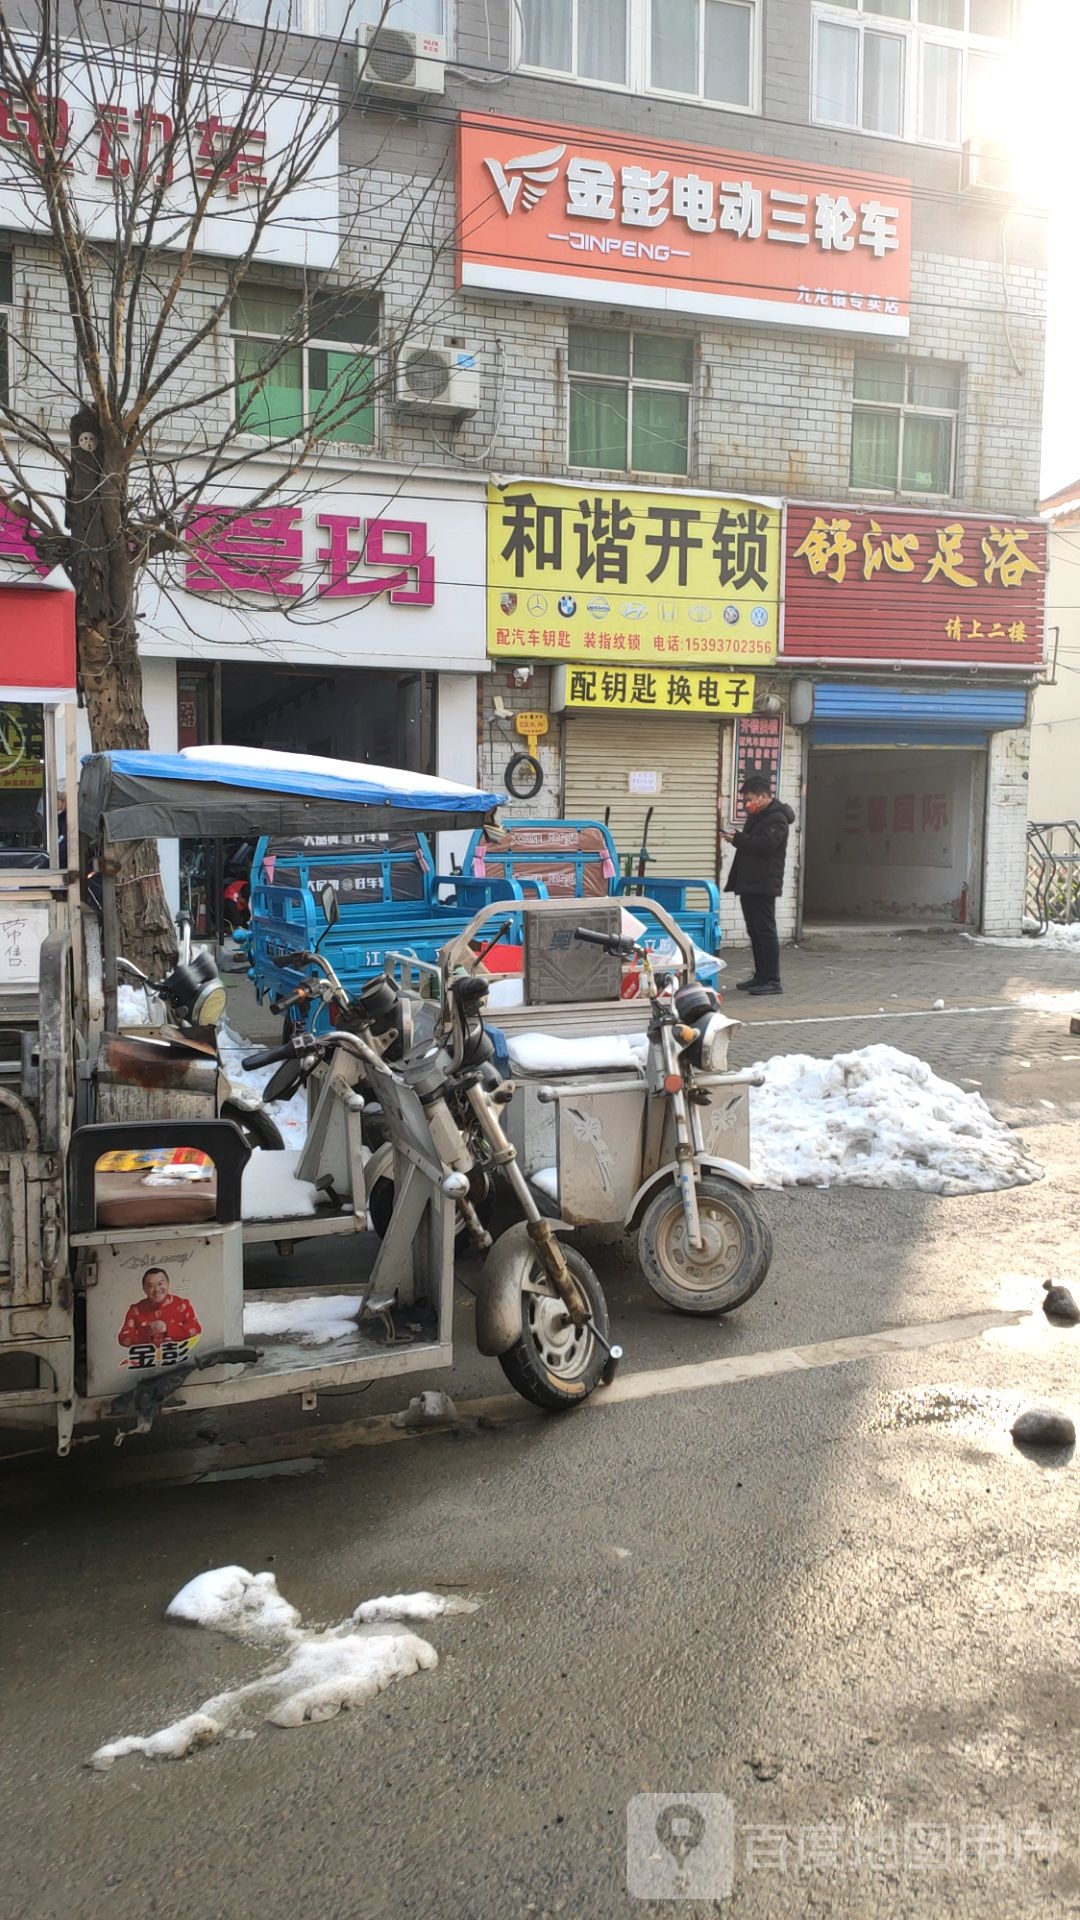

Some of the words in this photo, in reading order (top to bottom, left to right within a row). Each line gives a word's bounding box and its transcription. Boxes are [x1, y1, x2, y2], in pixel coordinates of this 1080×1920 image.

[566, 156, 900, 258] 金彭电动三轮车
[569, 231, 670, 262] JINPENG
[186, 504, 435, 607] 爱玛
[501, 493, 770, 592] 和谐开锁
[792, 516, 1041, 588] 舒沁足浴
[496, 627, 572, 649] 配汽车钥匙
[583, 631, 642, 652] 装指纹锁
[653, 634, 772, 655] 电话:15393702356
[944, 615, 1029, 643] 请上二楼
[570, 670, 657, 704] 配钥匙
[667, 673, 750, 707] 换电子
[128, 1340, 190, 1370] 金彭
